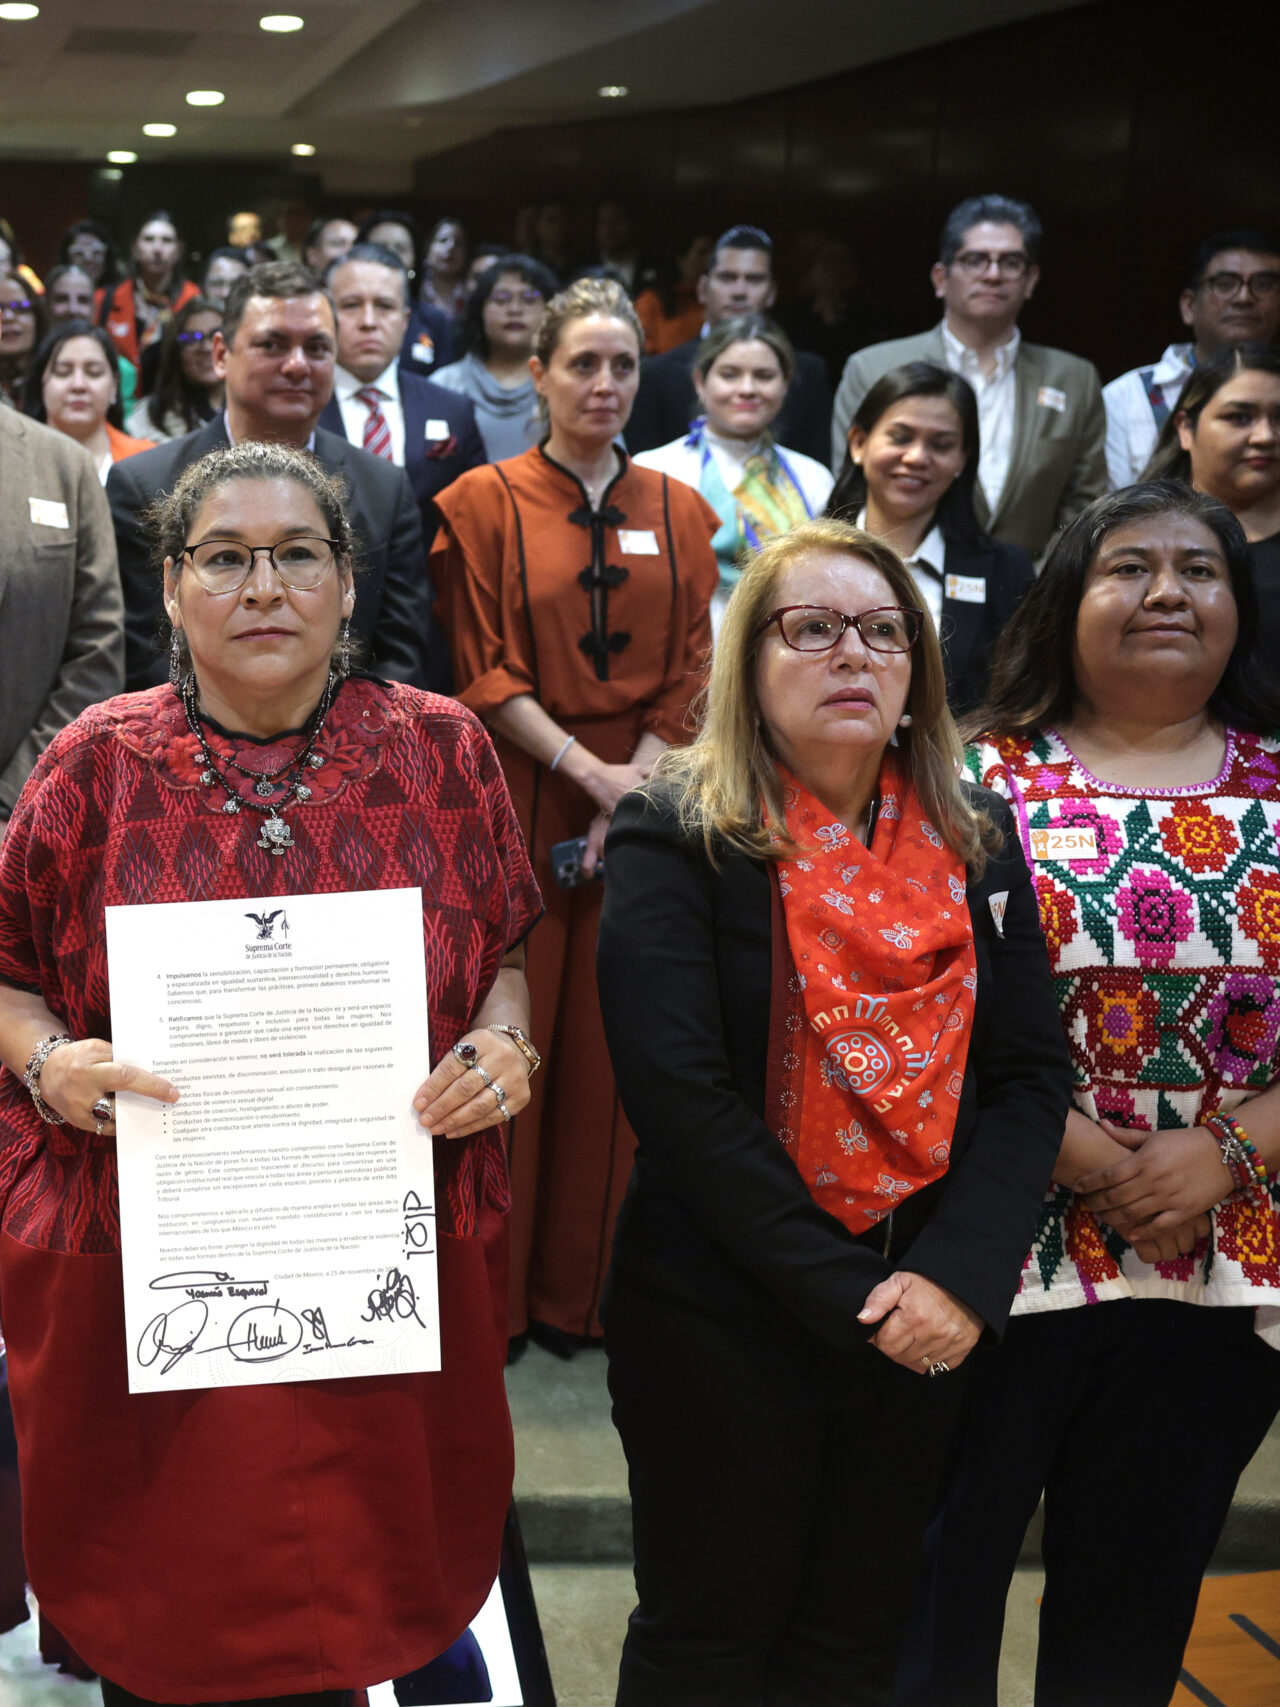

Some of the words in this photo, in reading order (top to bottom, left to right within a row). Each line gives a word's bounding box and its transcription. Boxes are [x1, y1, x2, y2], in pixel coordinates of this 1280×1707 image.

[1051, 834, 1095, 849] 25N
[245, 943, 274, 954] Suprema
[274, 942, 292, 951] Corte
